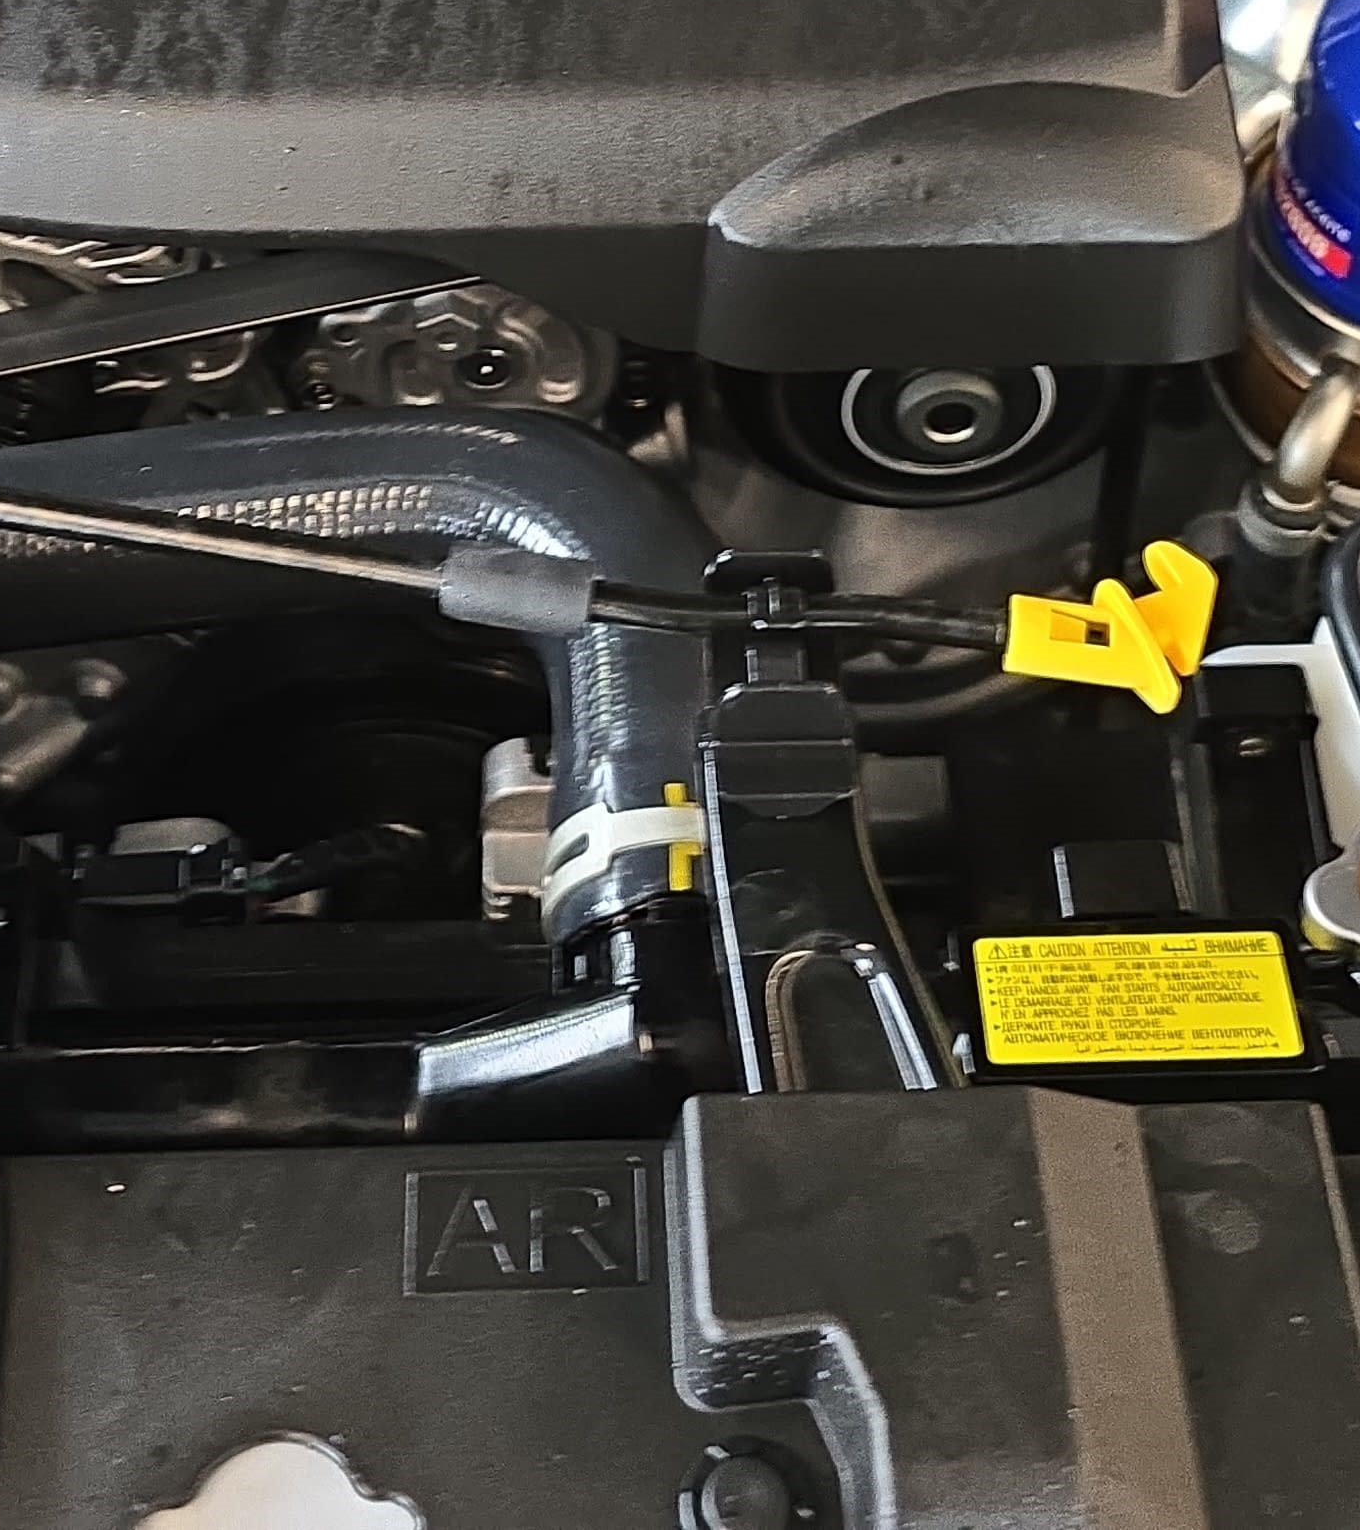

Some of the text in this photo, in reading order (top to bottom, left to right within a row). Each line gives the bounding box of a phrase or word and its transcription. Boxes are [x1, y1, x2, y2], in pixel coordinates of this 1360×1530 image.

[1039, 943, 1086, 958] CAUTION
[1093, 941, 1151, 957] ATTENTION
[1204, 937, 1268, 954] ВНИМАНИЕ
[998, 985, 1022, 996] KEEP
[1027, 985, 1060, 995] HANDS
[1077, 996, 1091, 1006] DU
[1032, 1007, 1089, 1019] APPROCHEZ
[1096, 1006, 1114, 1017] PAS
[1121, 1005, 1139, 1017] LES
[425, 1183, 620, 1277] AR
